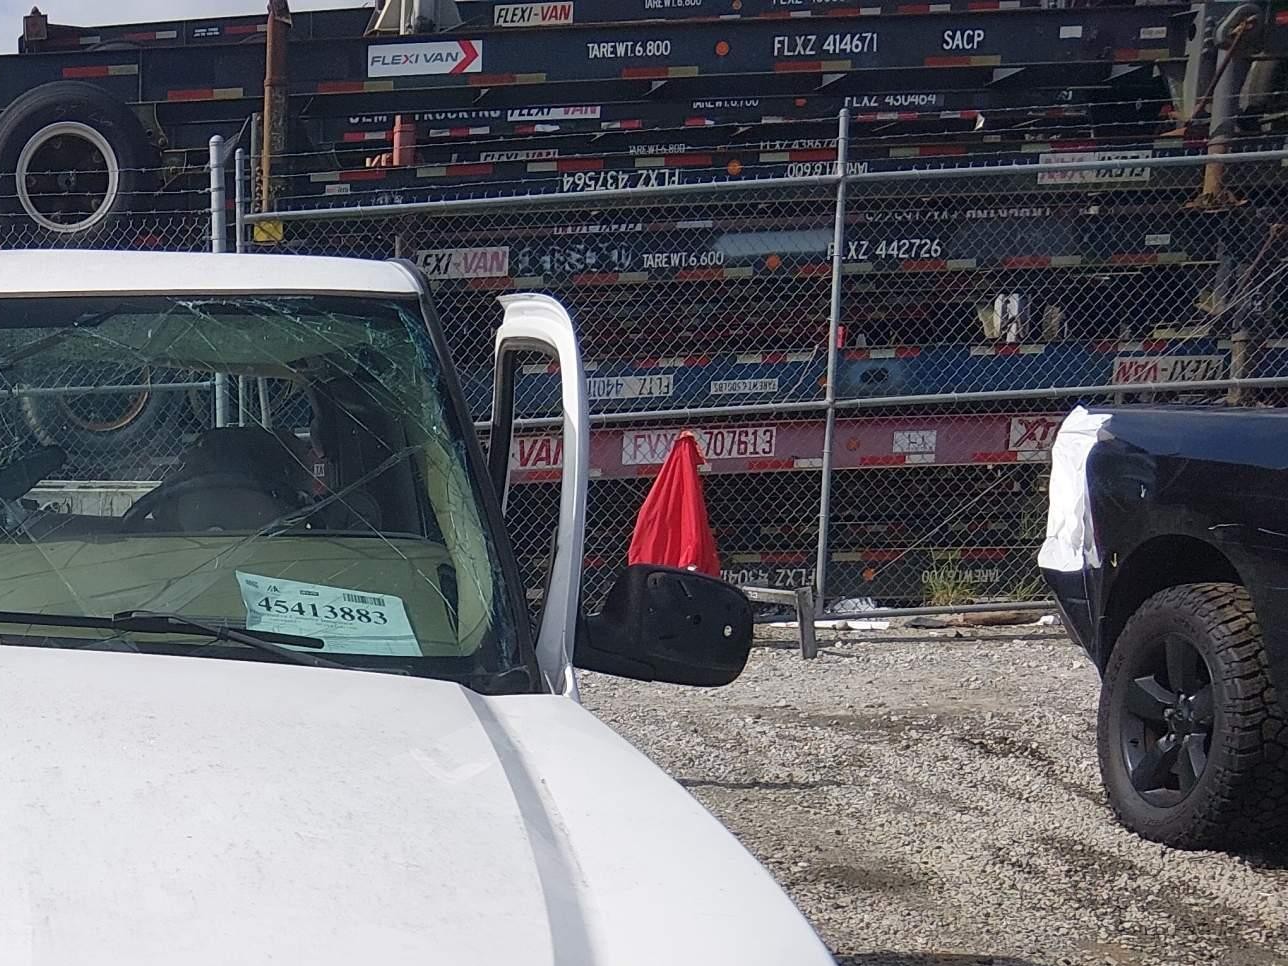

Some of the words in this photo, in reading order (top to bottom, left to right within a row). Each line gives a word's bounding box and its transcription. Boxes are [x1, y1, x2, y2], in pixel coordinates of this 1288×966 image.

[496, 5, 571, 23] FLEXI-VAN
[774, 36, 817, 57] FLXZ
[822, 33, 878, 54] 414671
[943, 30, 985, 50] SACP
[371, 54, 419, 66] FLEXI
[423, 52, 459, 63] VAN
[562, 170, 629, 192] 437564
[875, 238, 942, 259] 442726
[705, 428, 774, 457] 707613
[258, 596, 388, 626] 45413883
